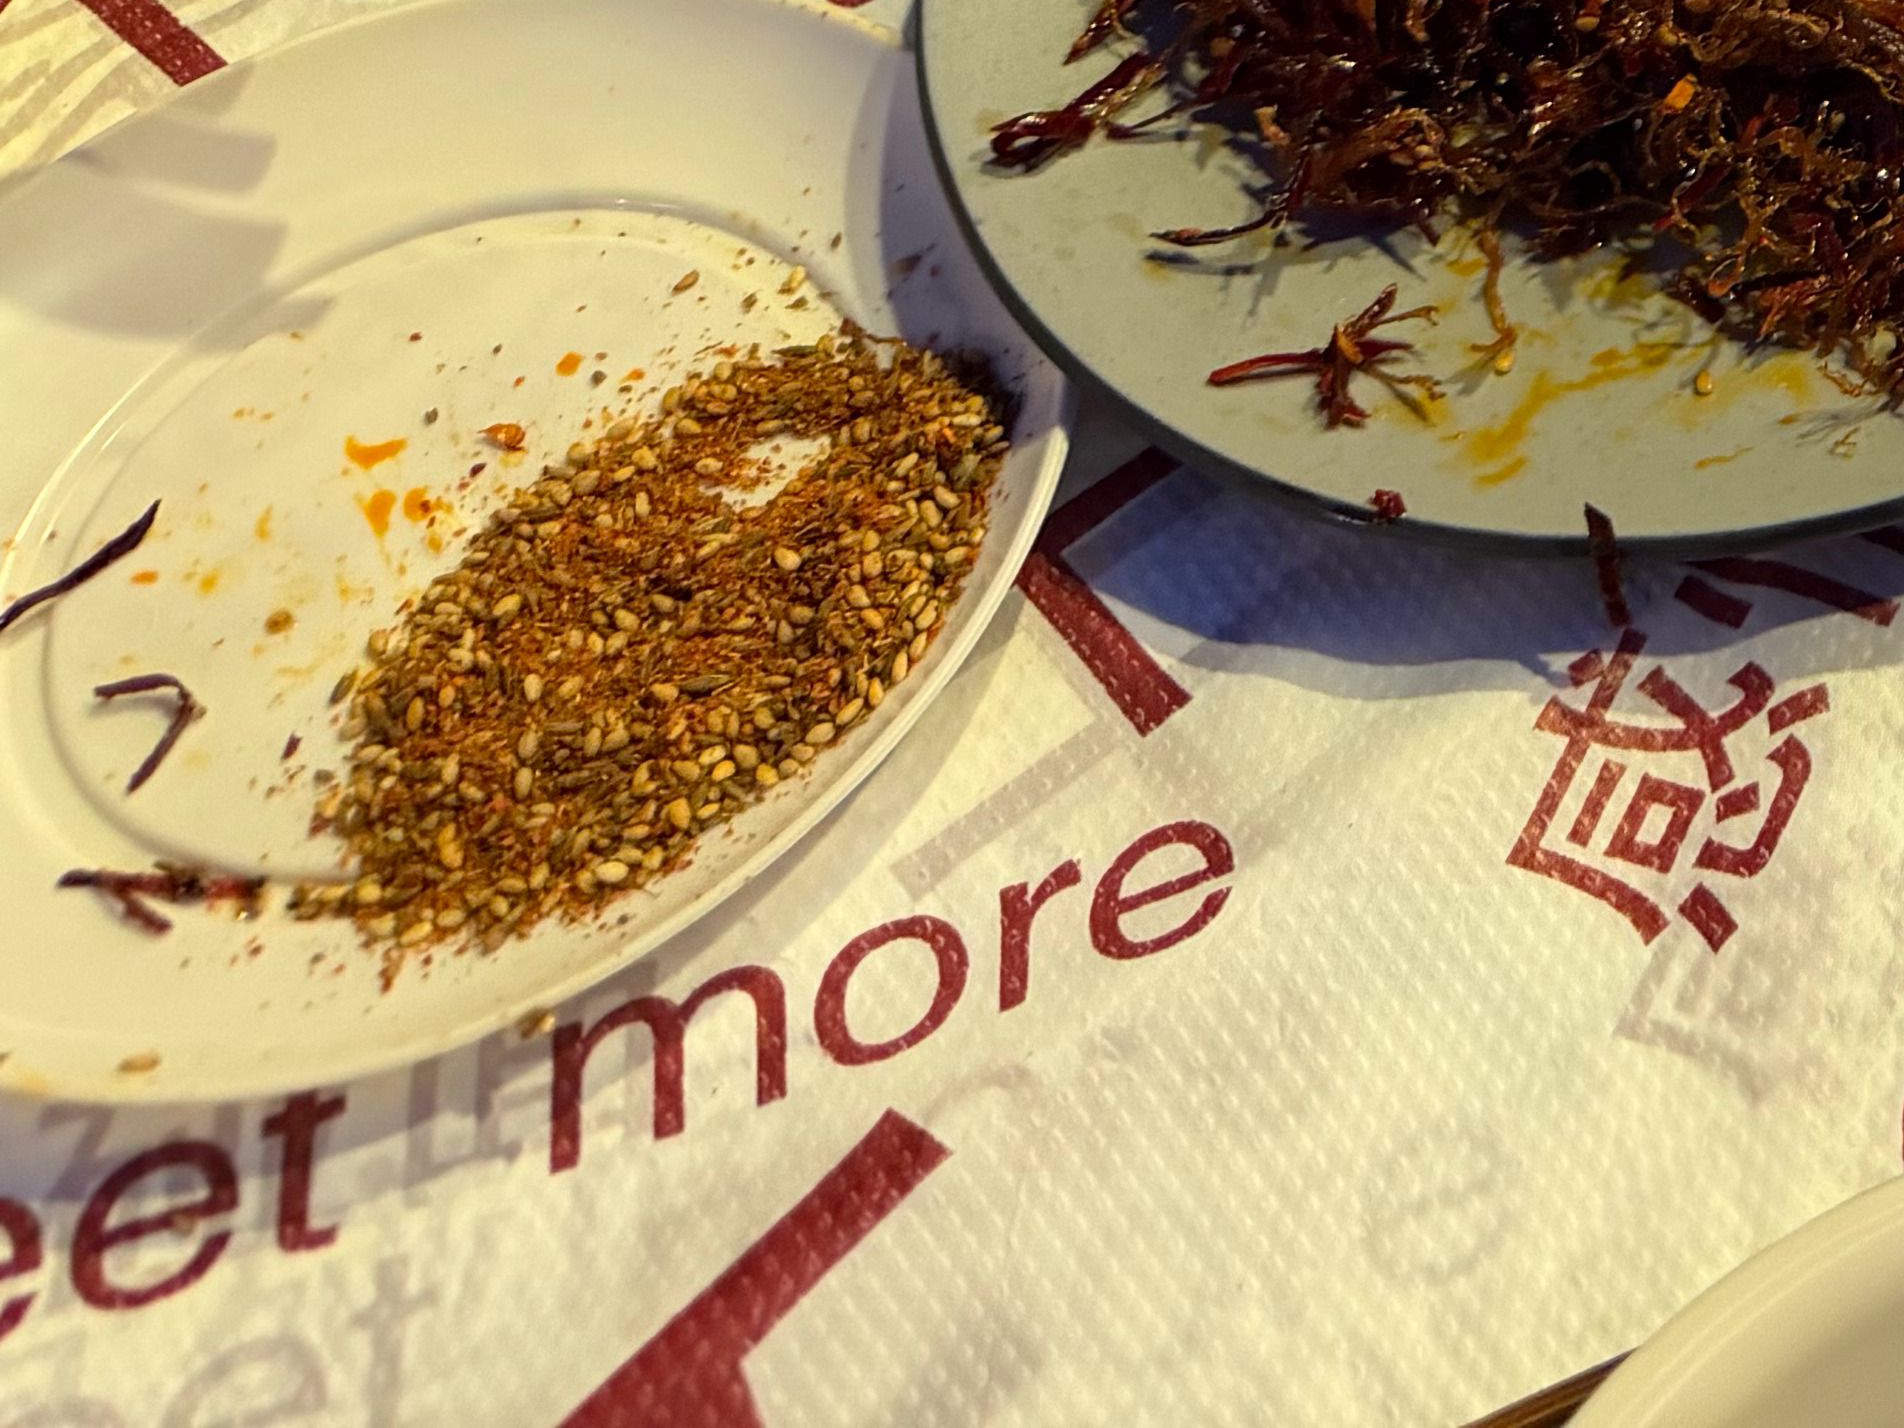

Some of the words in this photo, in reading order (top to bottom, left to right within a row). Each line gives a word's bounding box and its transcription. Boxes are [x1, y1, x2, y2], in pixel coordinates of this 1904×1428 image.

[1504, 626, 1832, 954] 感
[0, 1089, 347, 1340] et
[548, 817, 1237, 1176] more
